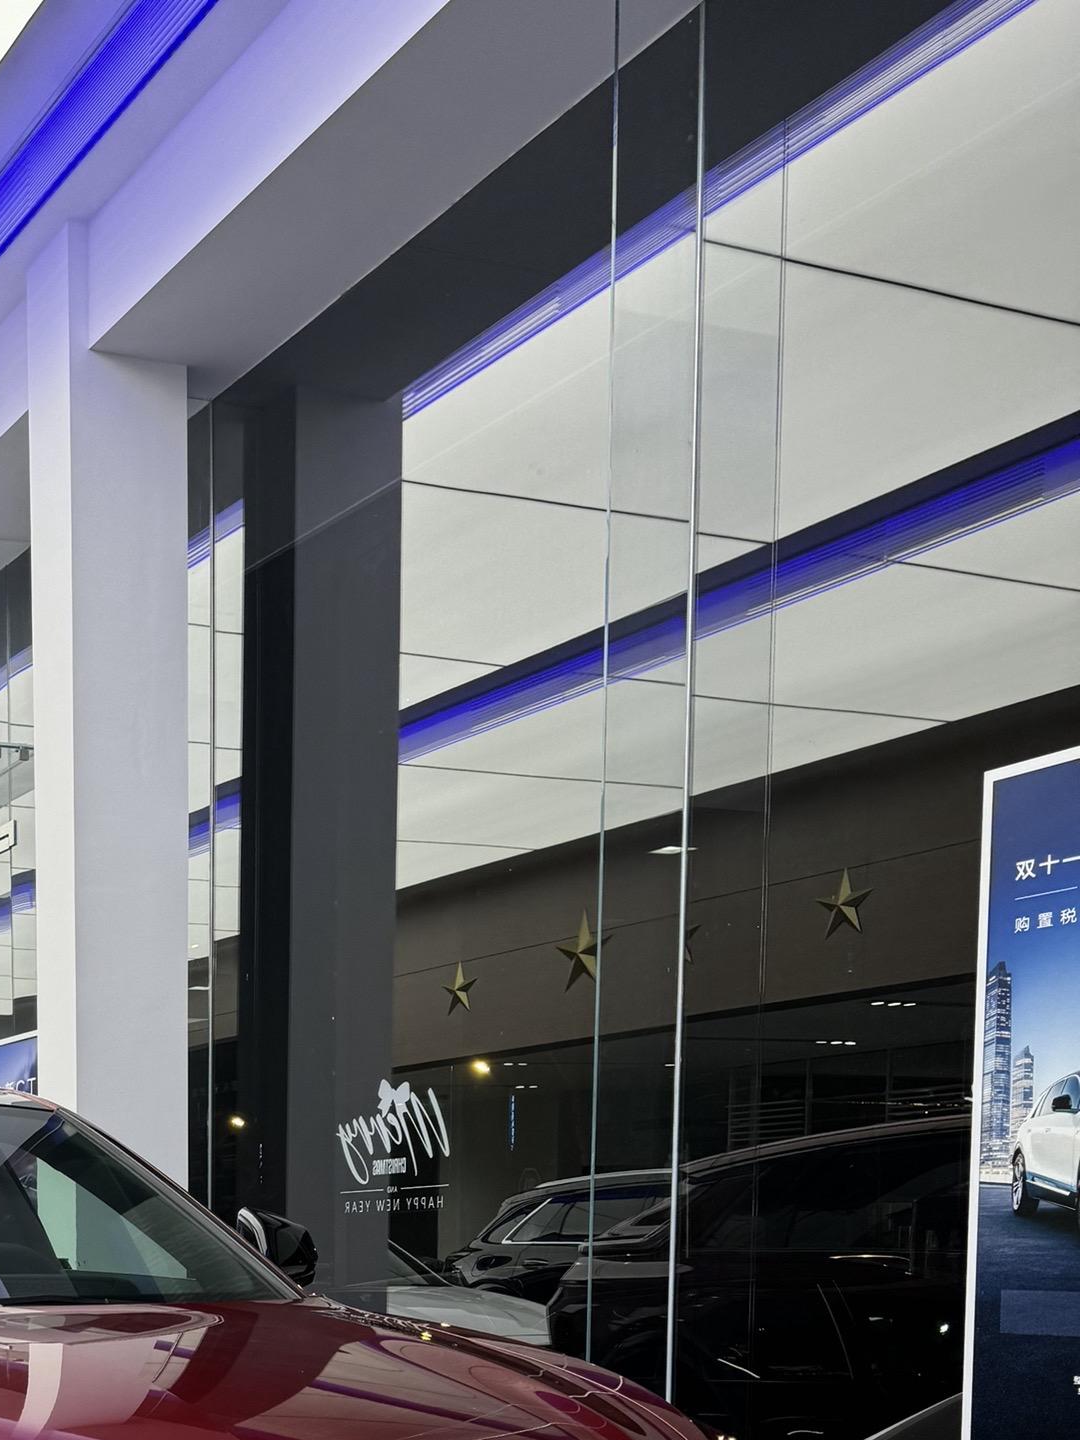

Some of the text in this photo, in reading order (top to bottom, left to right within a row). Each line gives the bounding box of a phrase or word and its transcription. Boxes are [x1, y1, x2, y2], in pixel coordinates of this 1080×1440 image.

[1015, 854, 1080, 881] 双十一
[1014, 907, 1078, 934] 购置税
